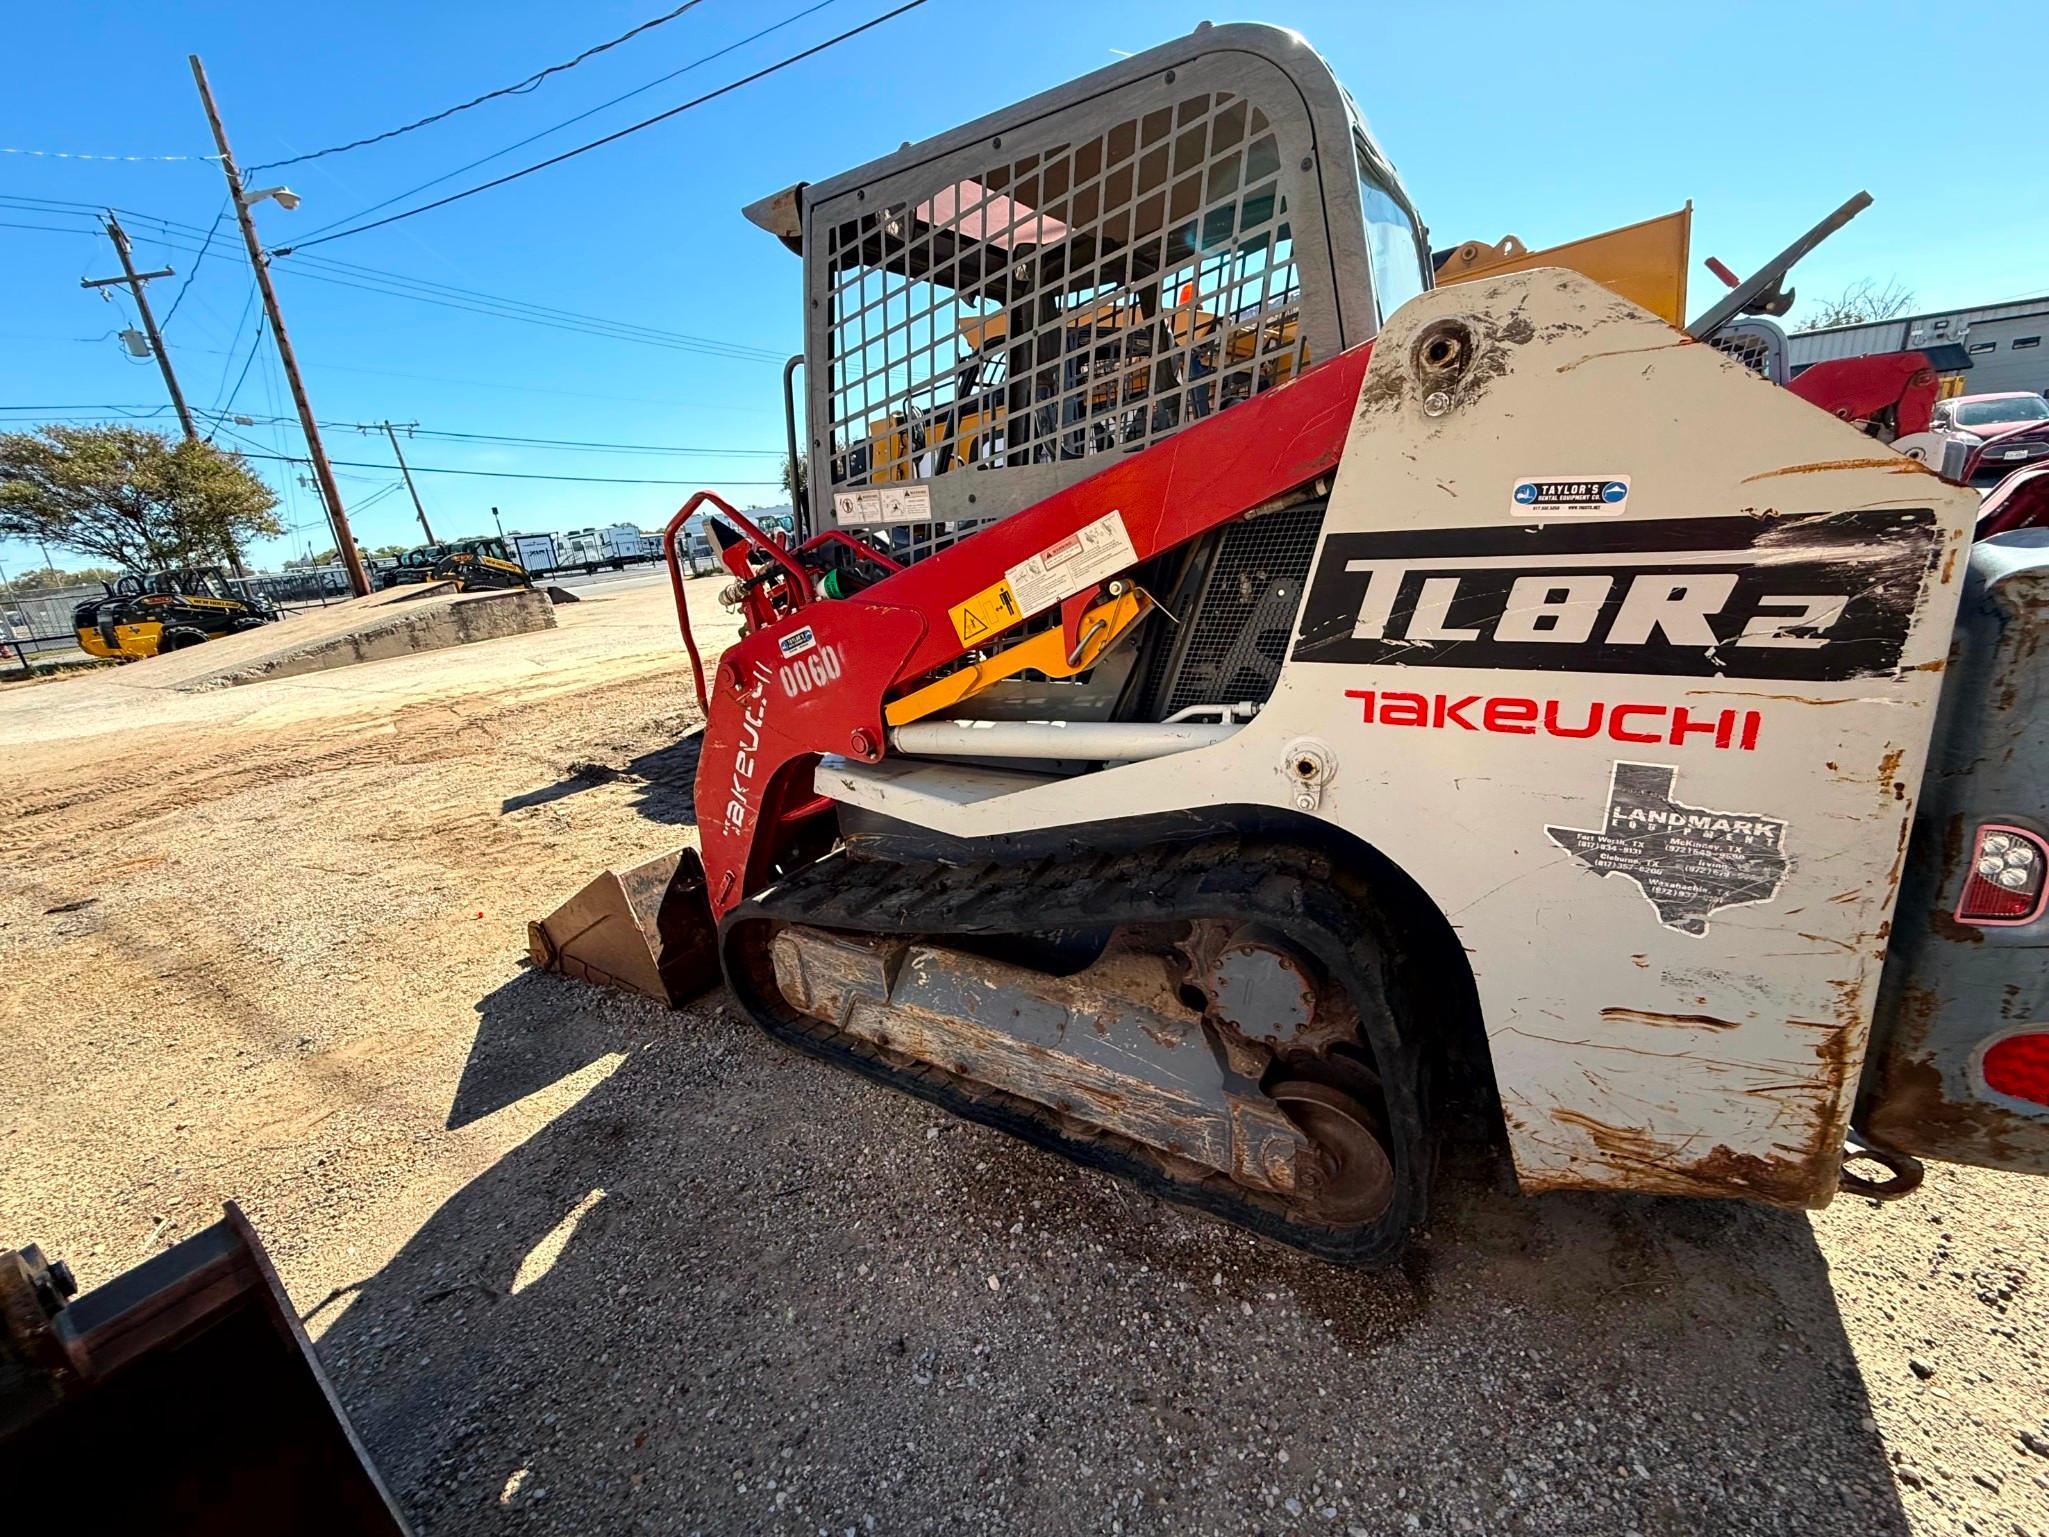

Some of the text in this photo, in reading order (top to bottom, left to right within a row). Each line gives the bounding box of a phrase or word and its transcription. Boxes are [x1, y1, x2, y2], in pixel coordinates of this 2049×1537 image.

[1541, 484, 1600, 495] TAYLOR'S
[1559, 493, 1590, 501] EQUIPMENT
[779, 645, 841, 697] 0060
[1344, 689, 1761, 751] TAKEUCHI
[1613, 806, 1776, 838] LANDMARK
[1611, 818, 1775, 847] EQUIPMENT
[1633, 841, 1645, 849] TX
[1728, 845, 1743, 854] TX
[1645, 859, 1659, 867] TX
